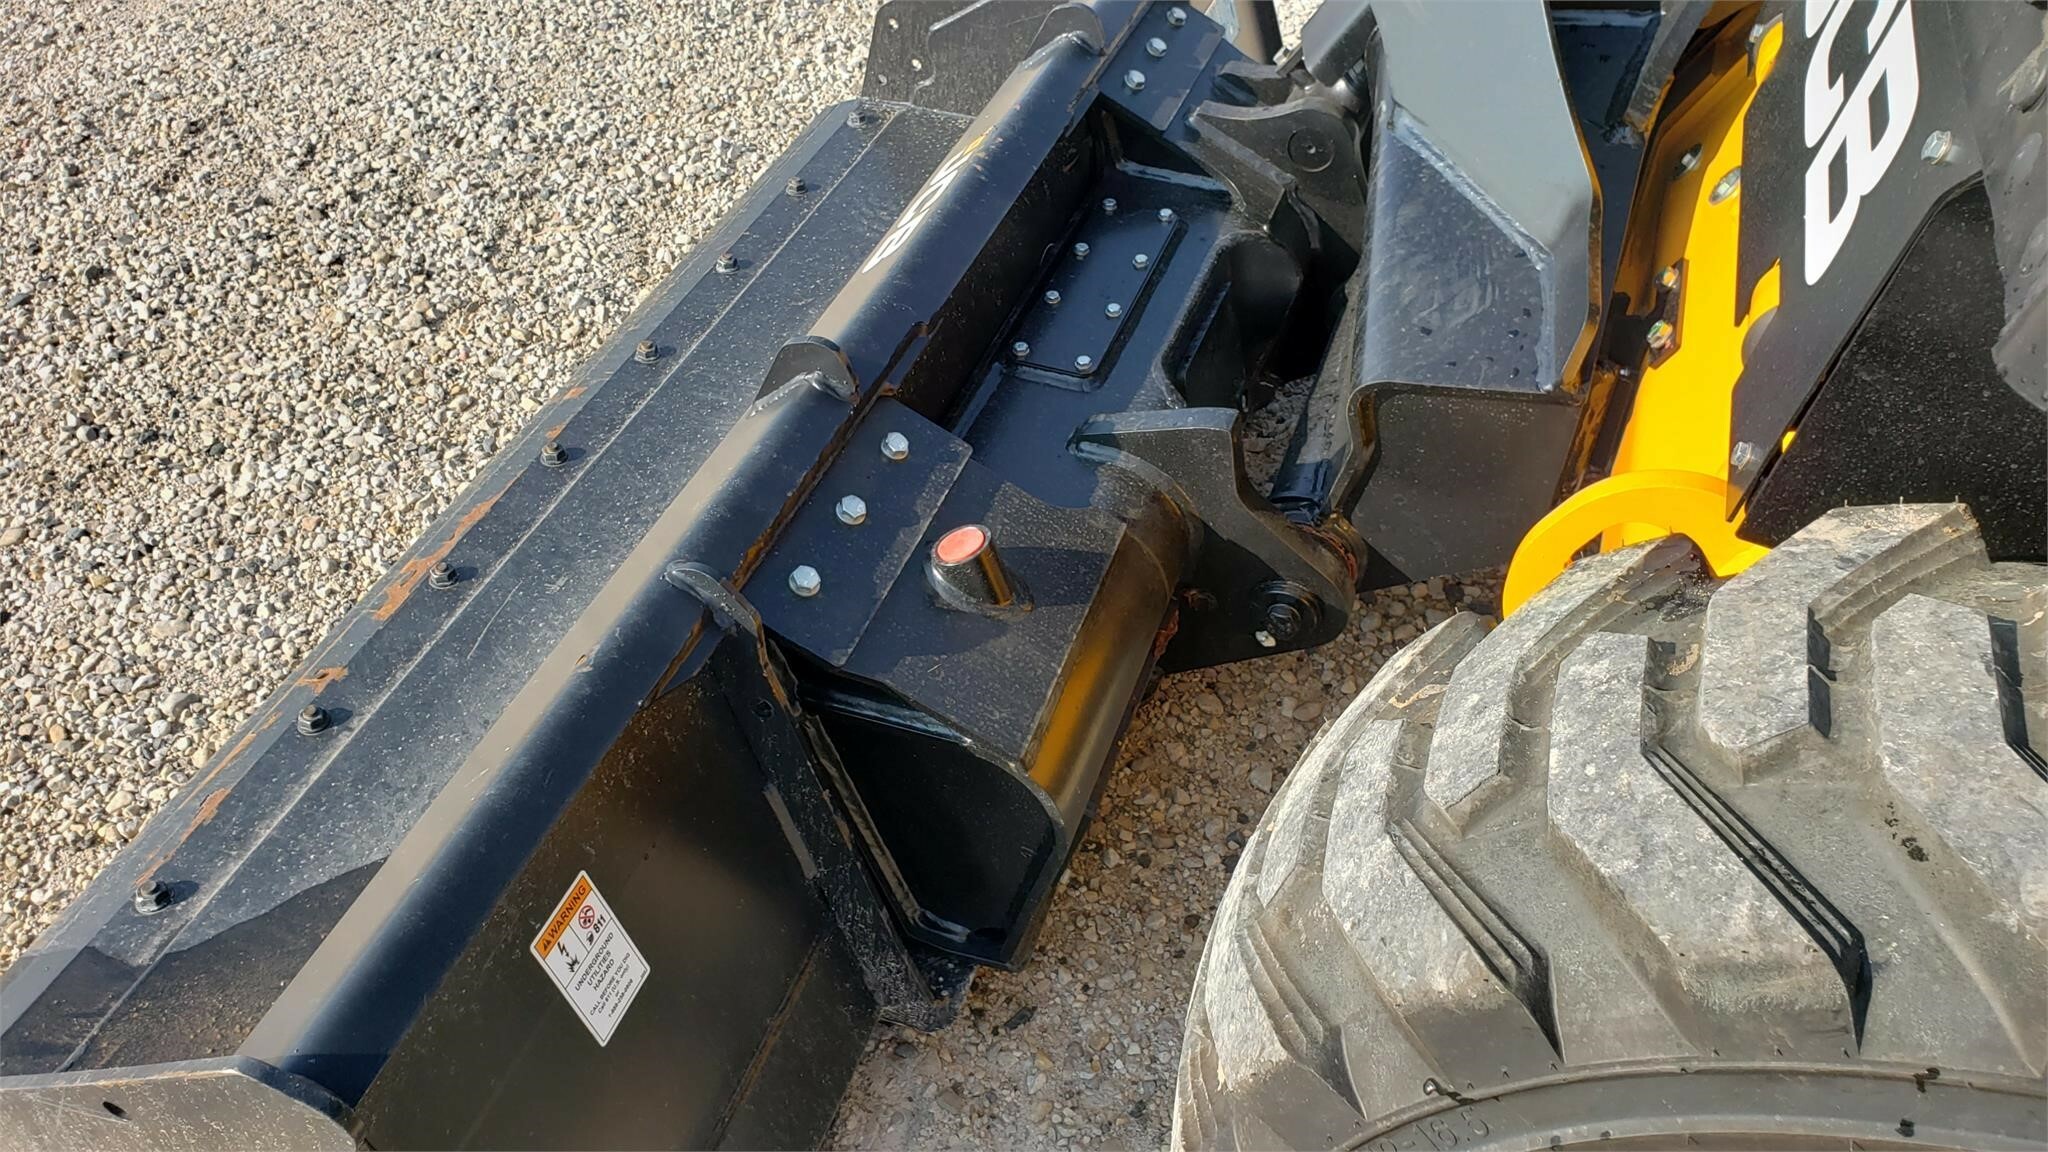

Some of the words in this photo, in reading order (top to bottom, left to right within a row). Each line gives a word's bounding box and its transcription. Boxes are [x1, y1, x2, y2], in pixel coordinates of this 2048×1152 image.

[1804, 0, 1919, 286] CB
[549, 884, 586, 938] WARNING
[593, 914, 606, 933] 811
[575, 932, 614, 991] UNDERGROUND
[587, 949, 611, 986] UTILITIES
[593, 958, 614, 991] HAZARD
[589, 999, 600, 1016] CALL
[599, 975, 615, 1000] BEFORE
[614, 962, 623, 975] YOU
